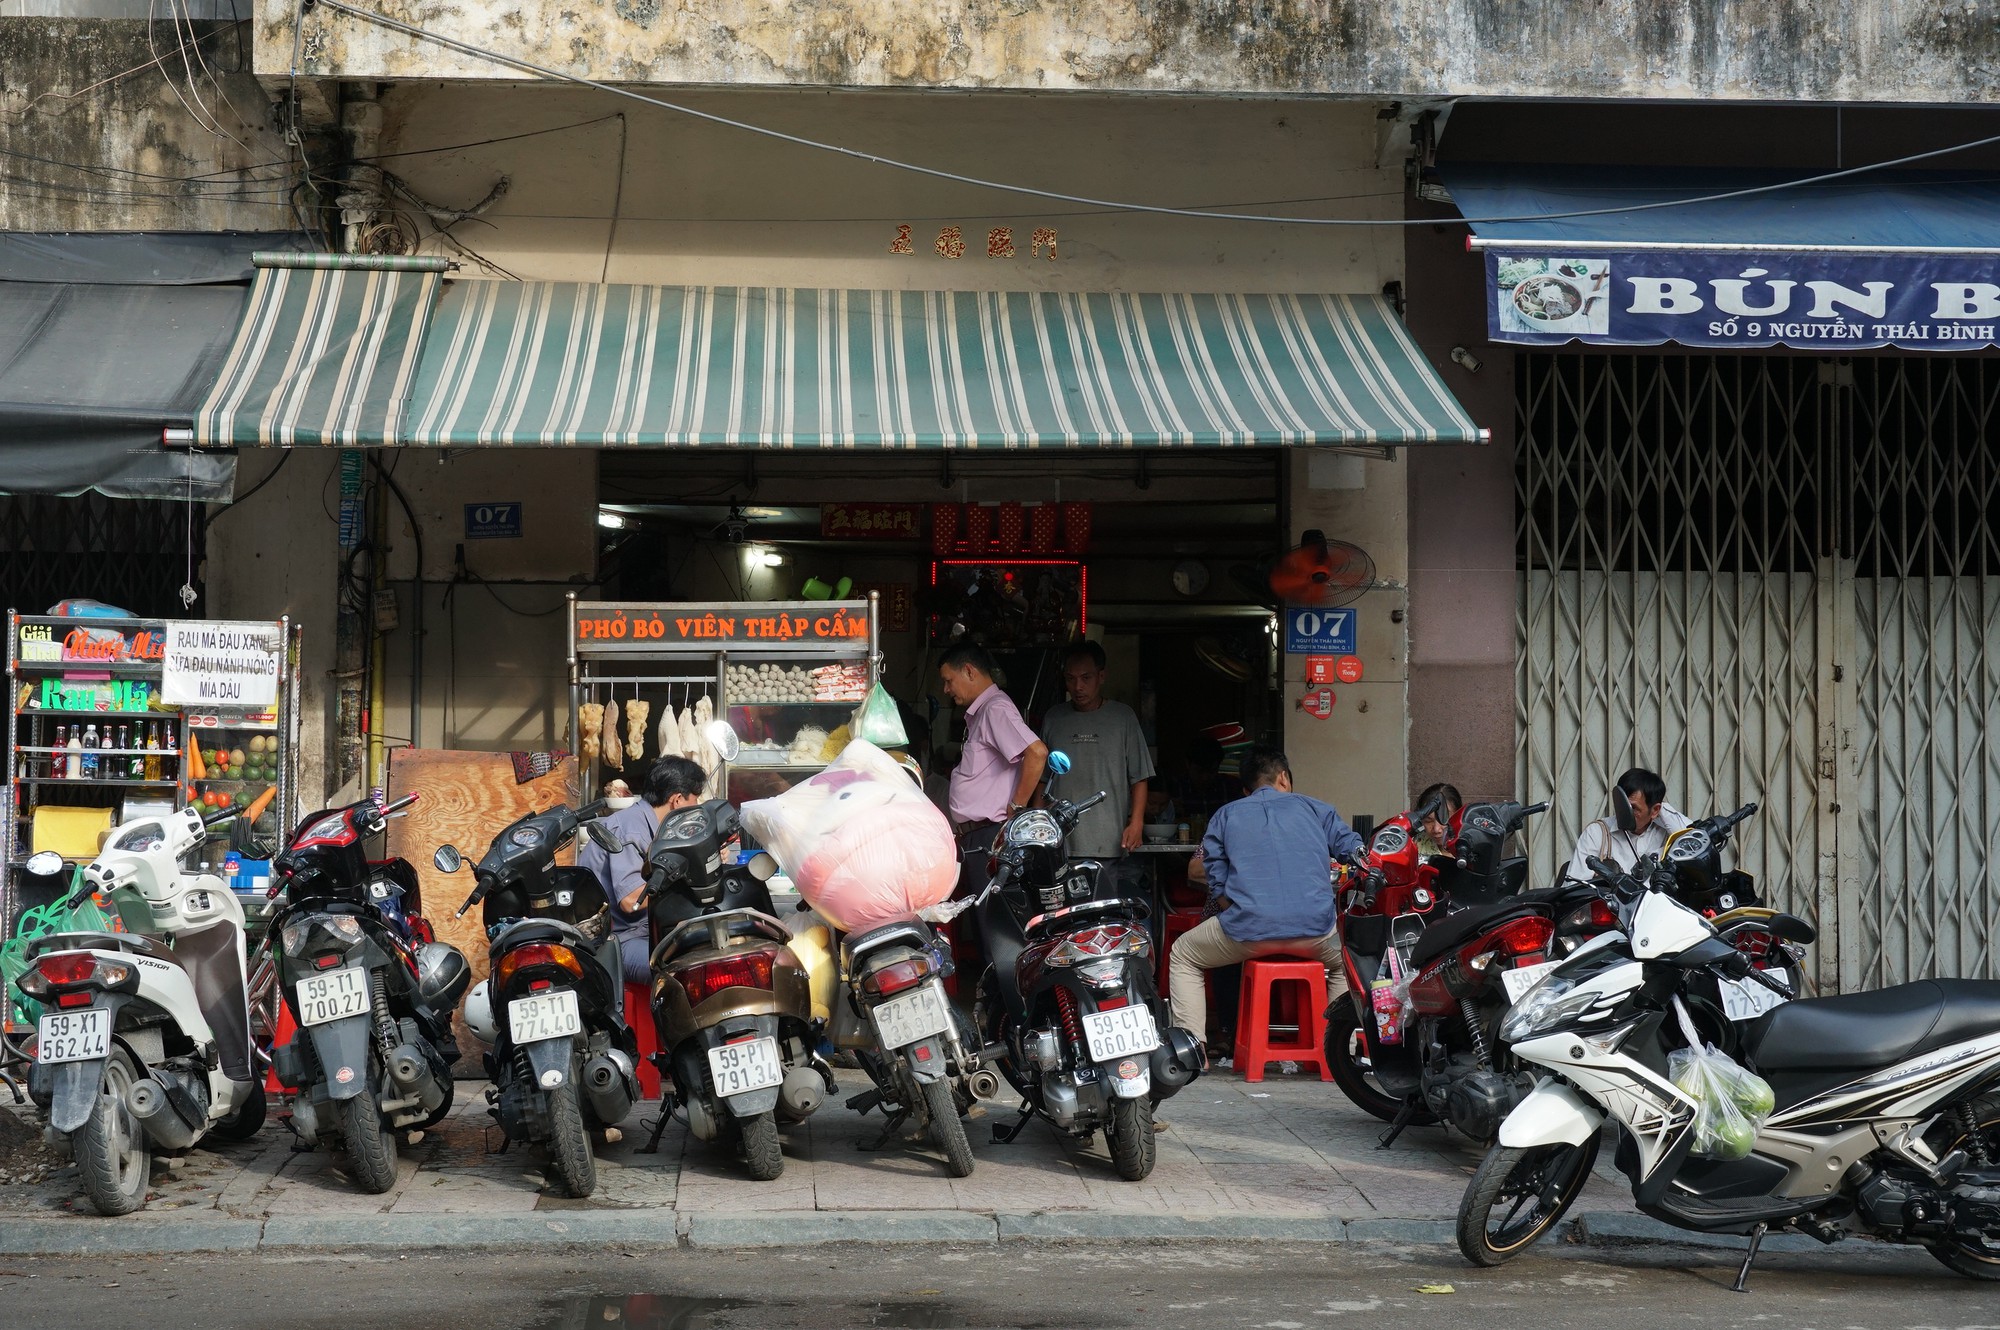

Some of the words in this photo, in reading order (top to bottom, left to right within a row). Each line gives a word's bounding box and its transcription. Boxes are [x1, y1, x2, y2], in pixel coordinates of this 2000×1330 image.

[1626, 268, 1894, 319] BÚN
[1708, 315, 1738, 337] SỐ
[1747, 322, 1761, 338] 9
[1769, 317, 1864, 339] NGUYỄN
[1872, 321, 1929, 339] THÁI
[1936, 322, 1995, 340] BÌNH
[475, 506, 512, 524] 07
[20, 625, 53, 641] Giải
[579, 610, 628, 639] PHỞ
[632, 612, 665, 638] BÒ
[675, 612, 736, 638] VIÊN
[744, 612, 809, 641] THẬP
[814, 608, 867, 637] CẨM
[1295, 612, 1348, 637] 07
[178, 631, 199, 648] RAU
[201, 628, 217, 649] MÁ
[219, 630, 240, 654] ĐẬU
[242, 633, 270, 650] XANH
[192, 653, 214, 677] ĐẬU
[216, 653, 244, 674] NÀNH
[246, 654, 275, 675] NÓNG
[41, 677, 95, 710] Rau
[110, 681, 149, 712] Má
[200, 677, 217, 698] MÍA
[219, 678, 240, 699] DÂU
[136, 958, 170, 971] VISION
[307, 972, 353, 999] 59-T1
[304, 991, 363, 1023] 700.27
[519, 995, 564, 1019] 59-T1
[50, 1013, 97, 1037] 59-X1
[515, 1013, 576, 1041] 774.40
[1093, 1009, 1139, 1035] 59-C1
[43, 1034, 104, 1060] 562.44
[719, 1043, 765, 1069] 59-P1
[1093, 1029, 1152, 1057] 860.46
[717, 1062, 777, 1093] 791.34
